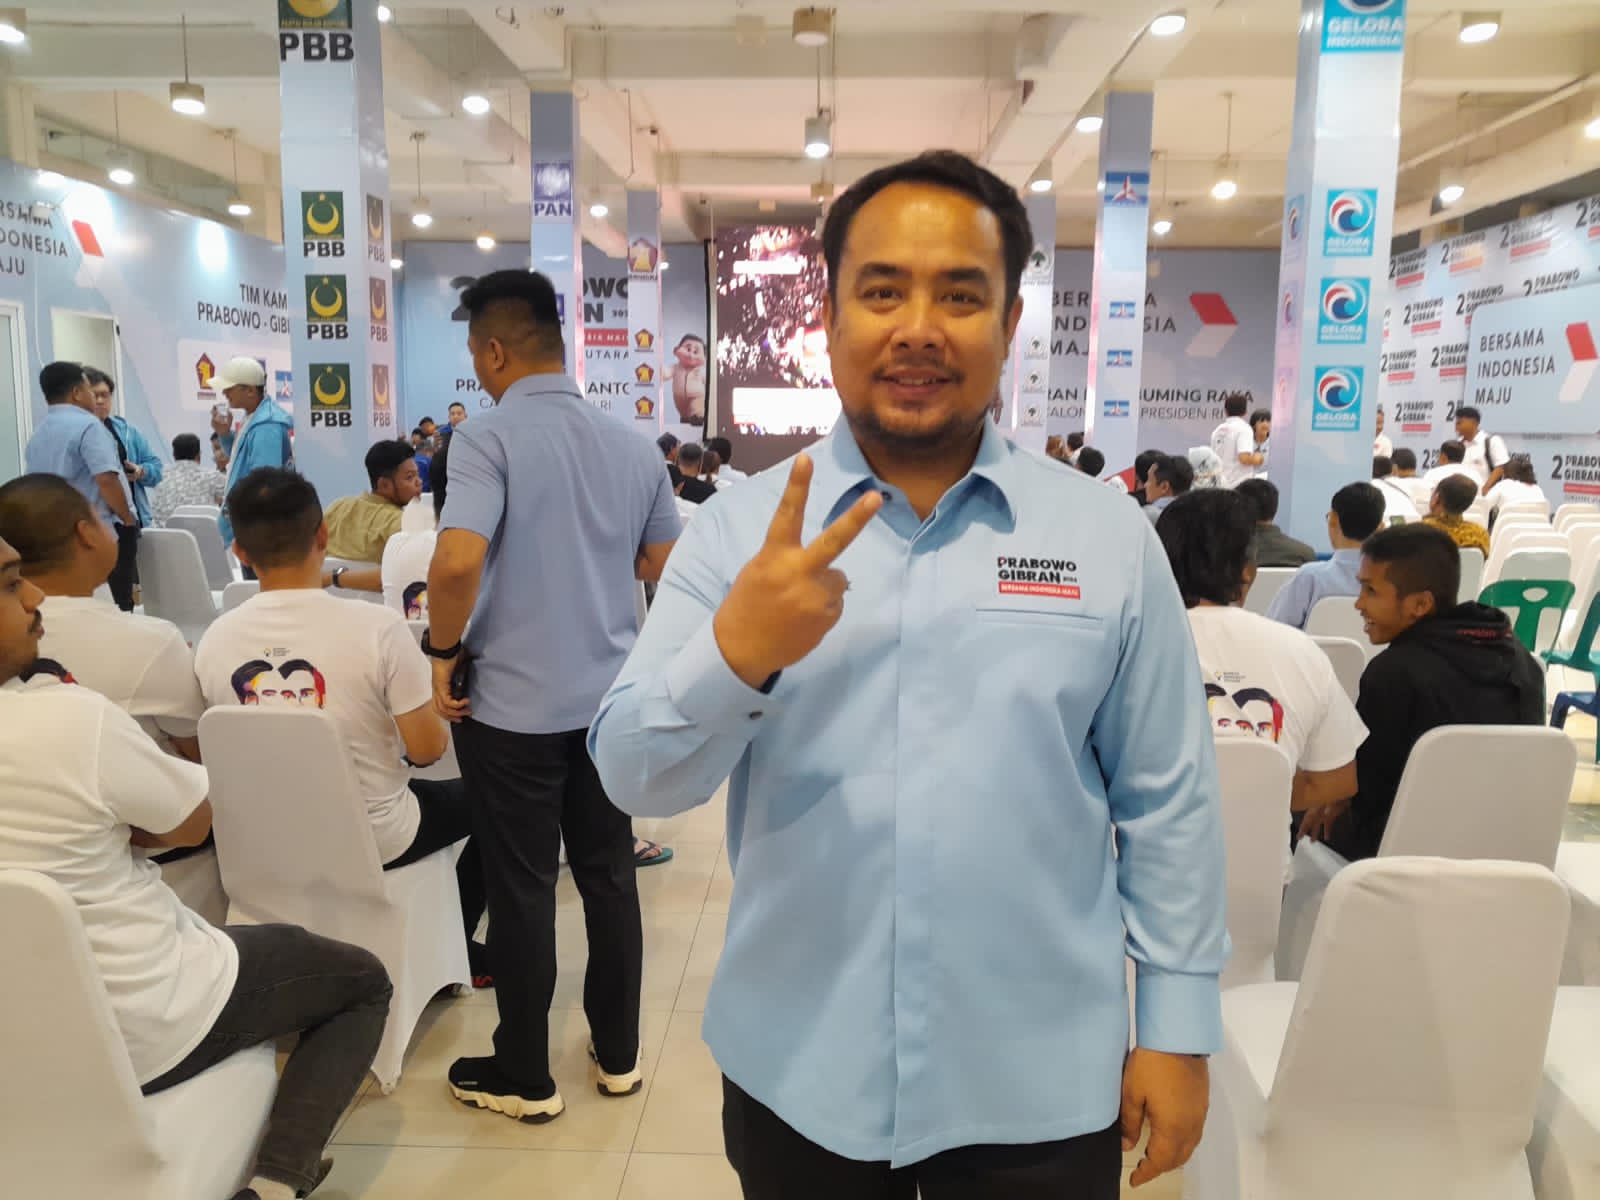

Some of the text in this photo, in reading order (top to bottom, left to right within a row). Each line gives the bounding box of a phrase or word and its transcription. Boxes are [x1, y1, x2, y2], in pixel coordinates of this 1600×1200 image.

[1328, 17, 1403, 33] GELORA
[279, 31, 354, 62] PBB
[534, 203, 572, 217] PAN
[1575, 201, 1589, 229] 2
[303, 241, 345, 257] PBB
[1441, 243, 1450, 265] 2
[240, 283, 260, 305] TIM
[1456, 293, 1465, 316] 2
[197, 301, 261, 329] PRABOWO
[1403, 304, 1412, 326] 2
[307, 324, 349, 340] PBB
[371, 325, 388, 342] PBB
[1480, 328, 1545, 353] BERSAMA
[1381, 354, 1389, 373] 2
[1431, 347, 1441, 369] 2
[1477, 355, 1556, 378] INDONESIA
[1475, 386, 1512, 405] MAJU
[311, 411, 352, 428] PBB
[374, 411, 391, 428] PBB
[1141, 407, 1207, 419] PRESIDEN
[1394, 403, 1403, 423] 2
[1446, 401, 1456, 423] 2
[1422, 449, 1431, 470] 2
[1551, 455, 1564, 480] 2
[997, 556, 1077, 572] PRABOWO
[998, 569, 1061, 584] GIBRAN
